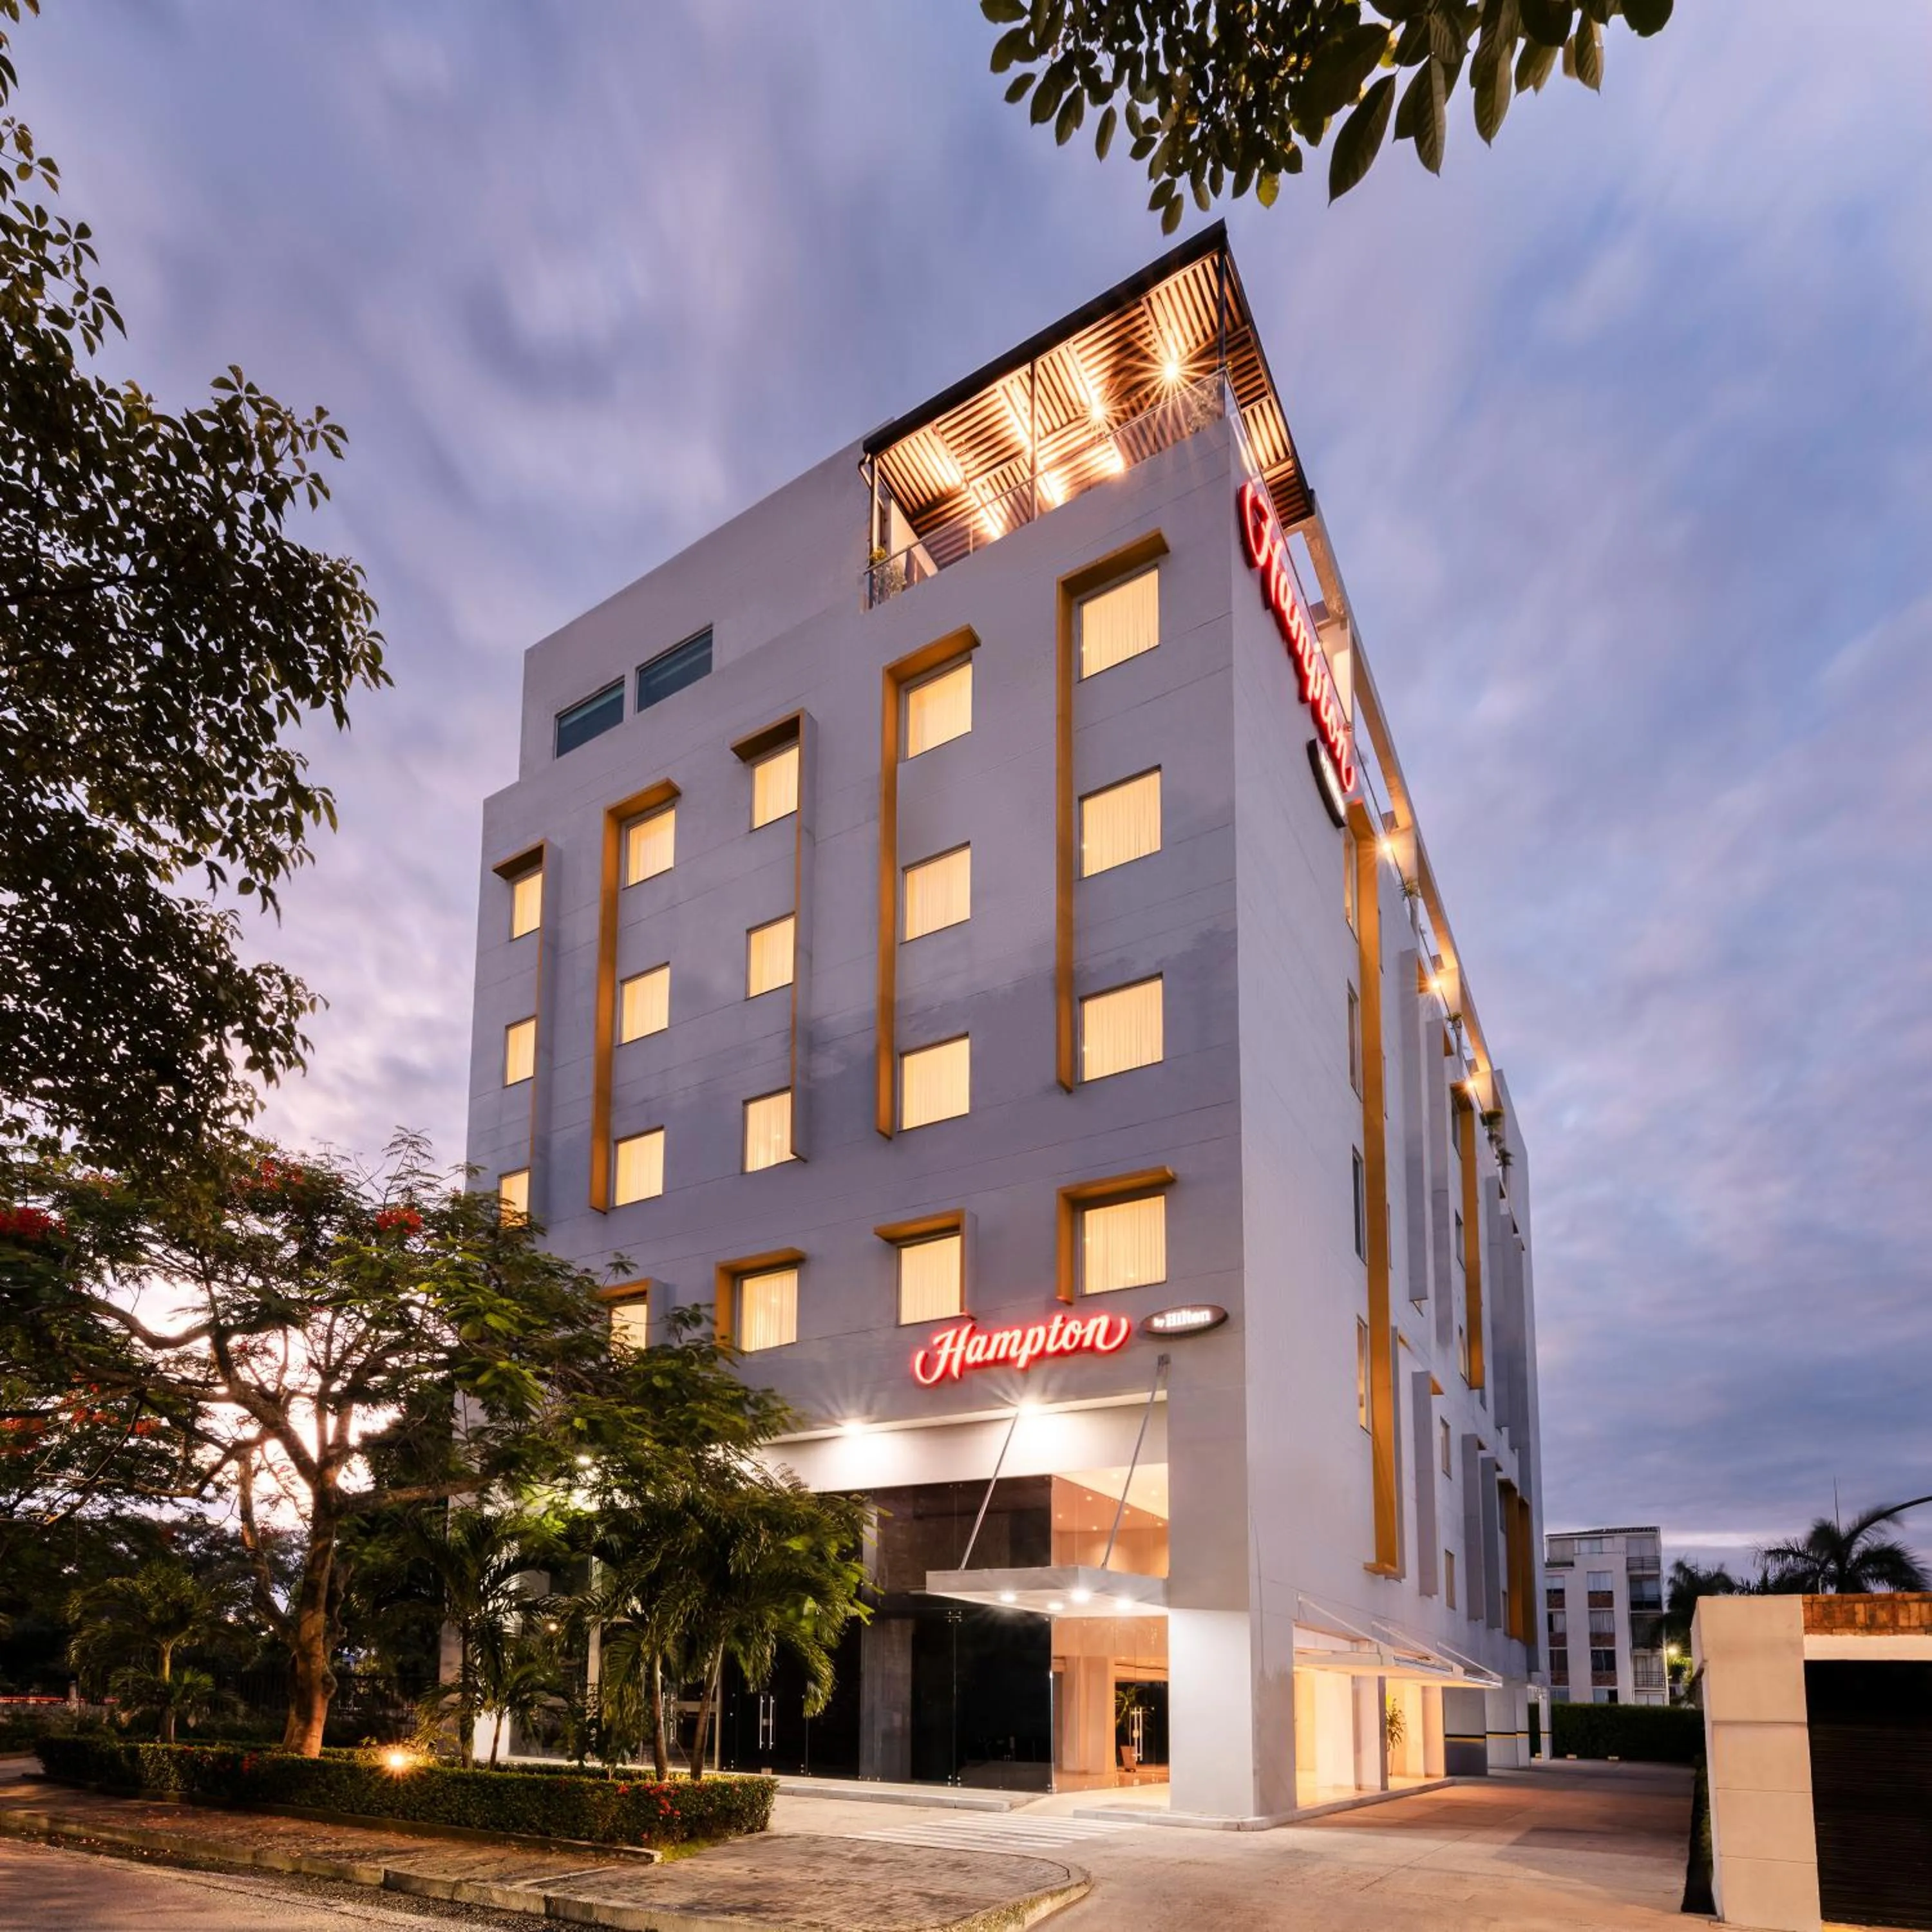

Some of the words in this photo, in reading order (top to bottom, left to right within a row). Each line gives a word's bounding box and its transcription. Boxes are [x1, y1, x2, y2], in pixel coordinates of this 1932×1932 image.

[1239, 481, 1356, 793] Hampton
[913, 1312, 1129, 1384] Hampton
[1165, 1310, 1211, 1327] Hilton
